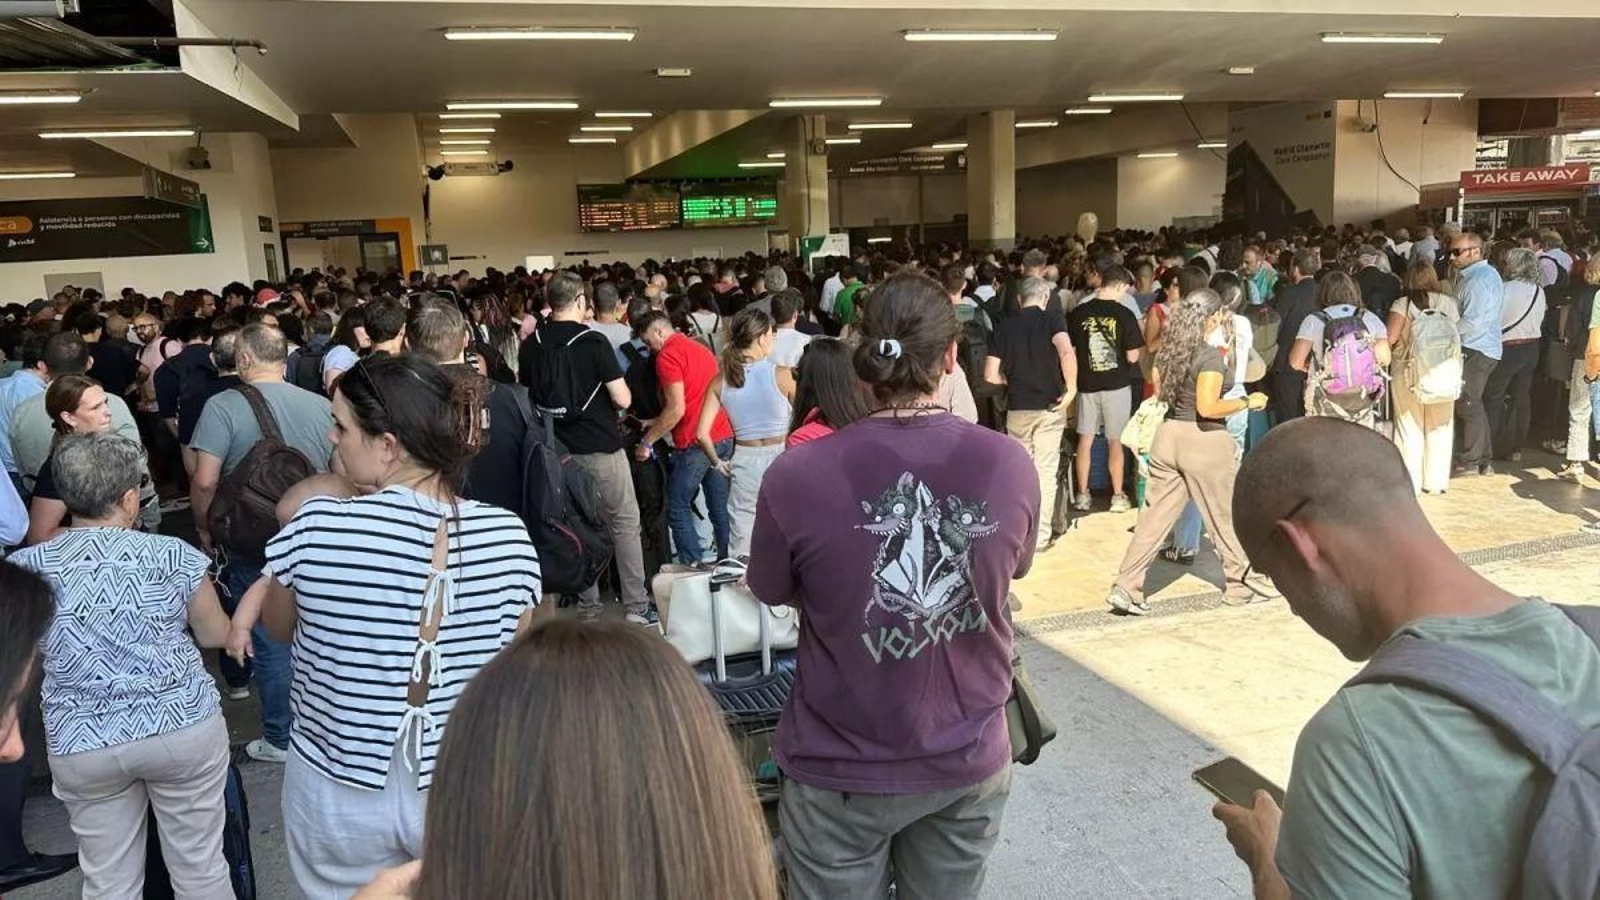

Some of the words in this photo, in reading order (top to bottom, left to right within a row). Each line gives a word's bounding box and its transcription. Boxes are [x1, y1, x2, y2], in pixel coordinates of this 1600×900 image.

[1472, 172, 1520, 184] TAKE
[1523, 169, 1578, 182] AWAY
[39, 215, 76, 224] Asistencia
[84, 215, 117, 223] personas
[133, 211, 181, 221] discapacidad
[861, 606, 987, 664] VOLCOM
